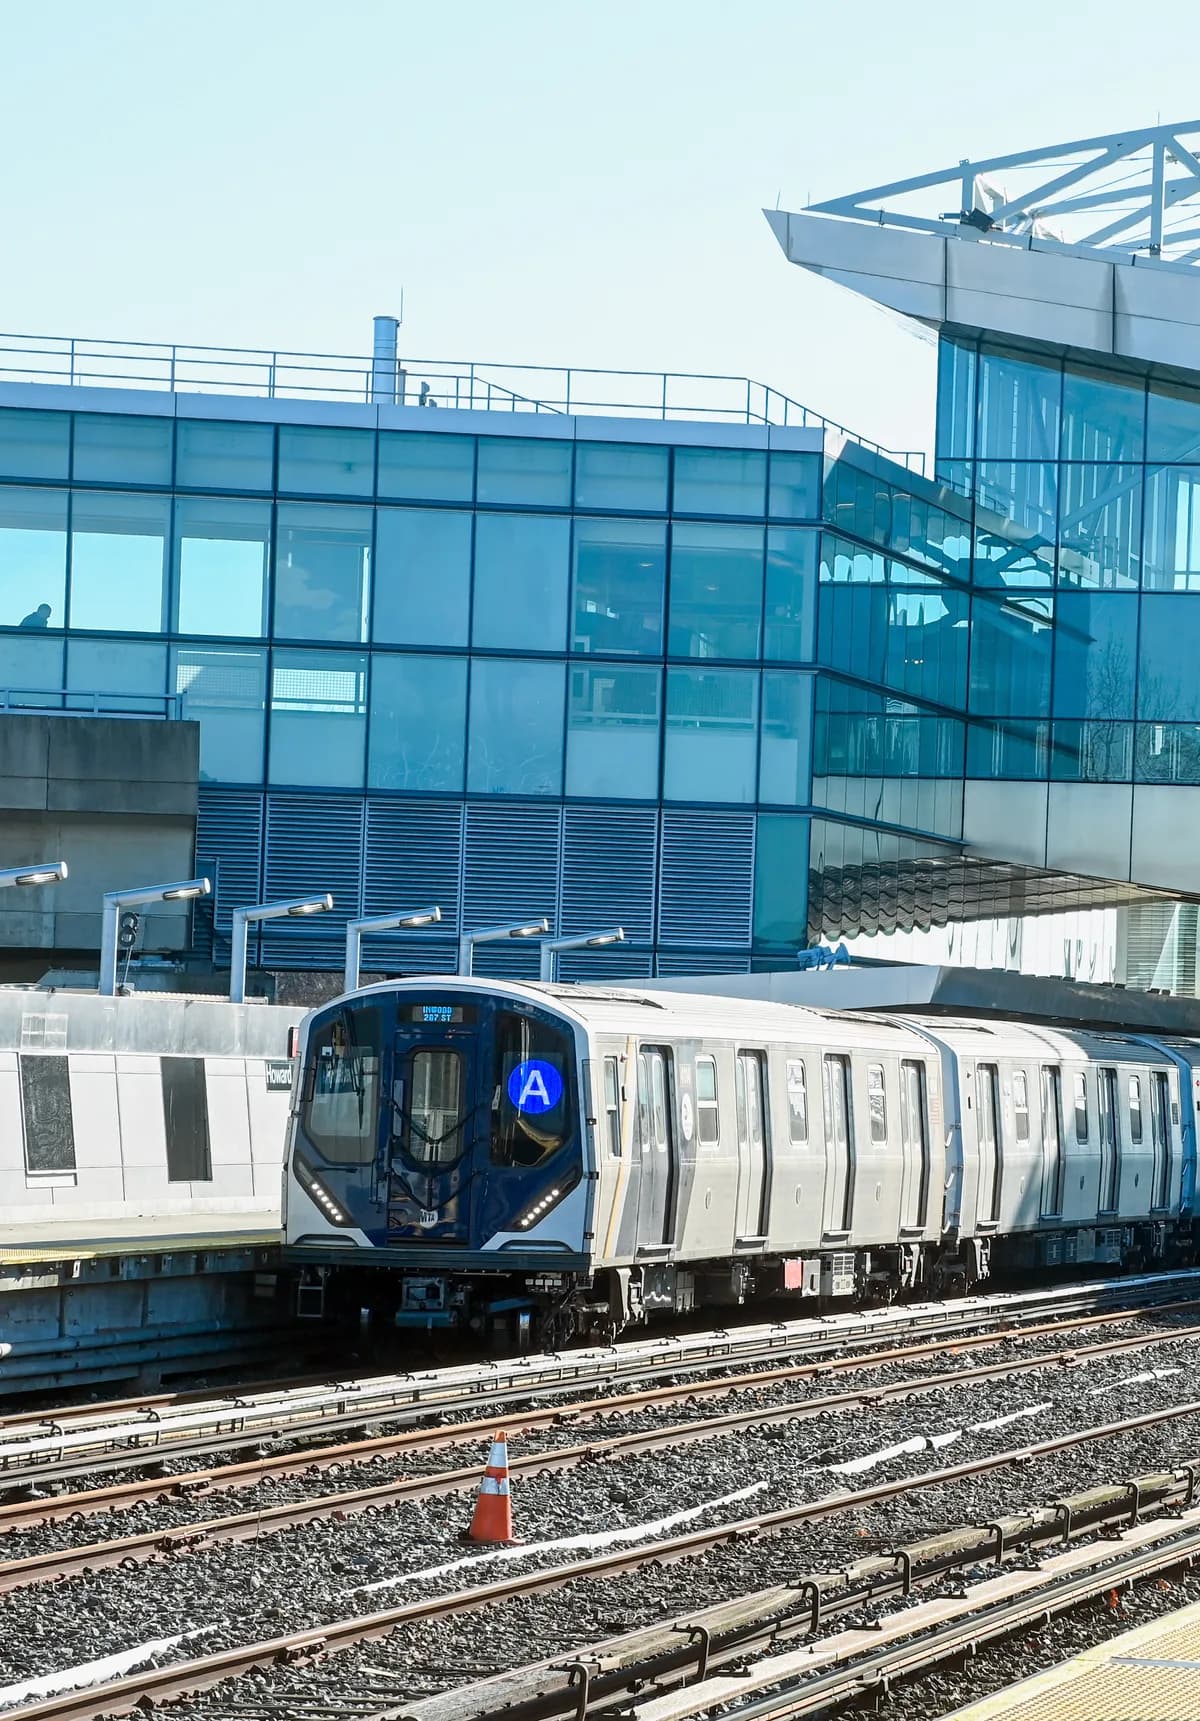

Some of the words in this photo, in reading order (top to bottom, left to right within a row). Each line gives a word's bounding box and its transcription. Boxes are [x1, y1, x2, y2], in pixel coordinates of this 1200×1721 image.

[423, 1014, 439, 1022] 207
[440, 1014, 452, 1022] ST
[266, 1063, 292, 1084] Howard
[518, 1069, 550, 1105] A
